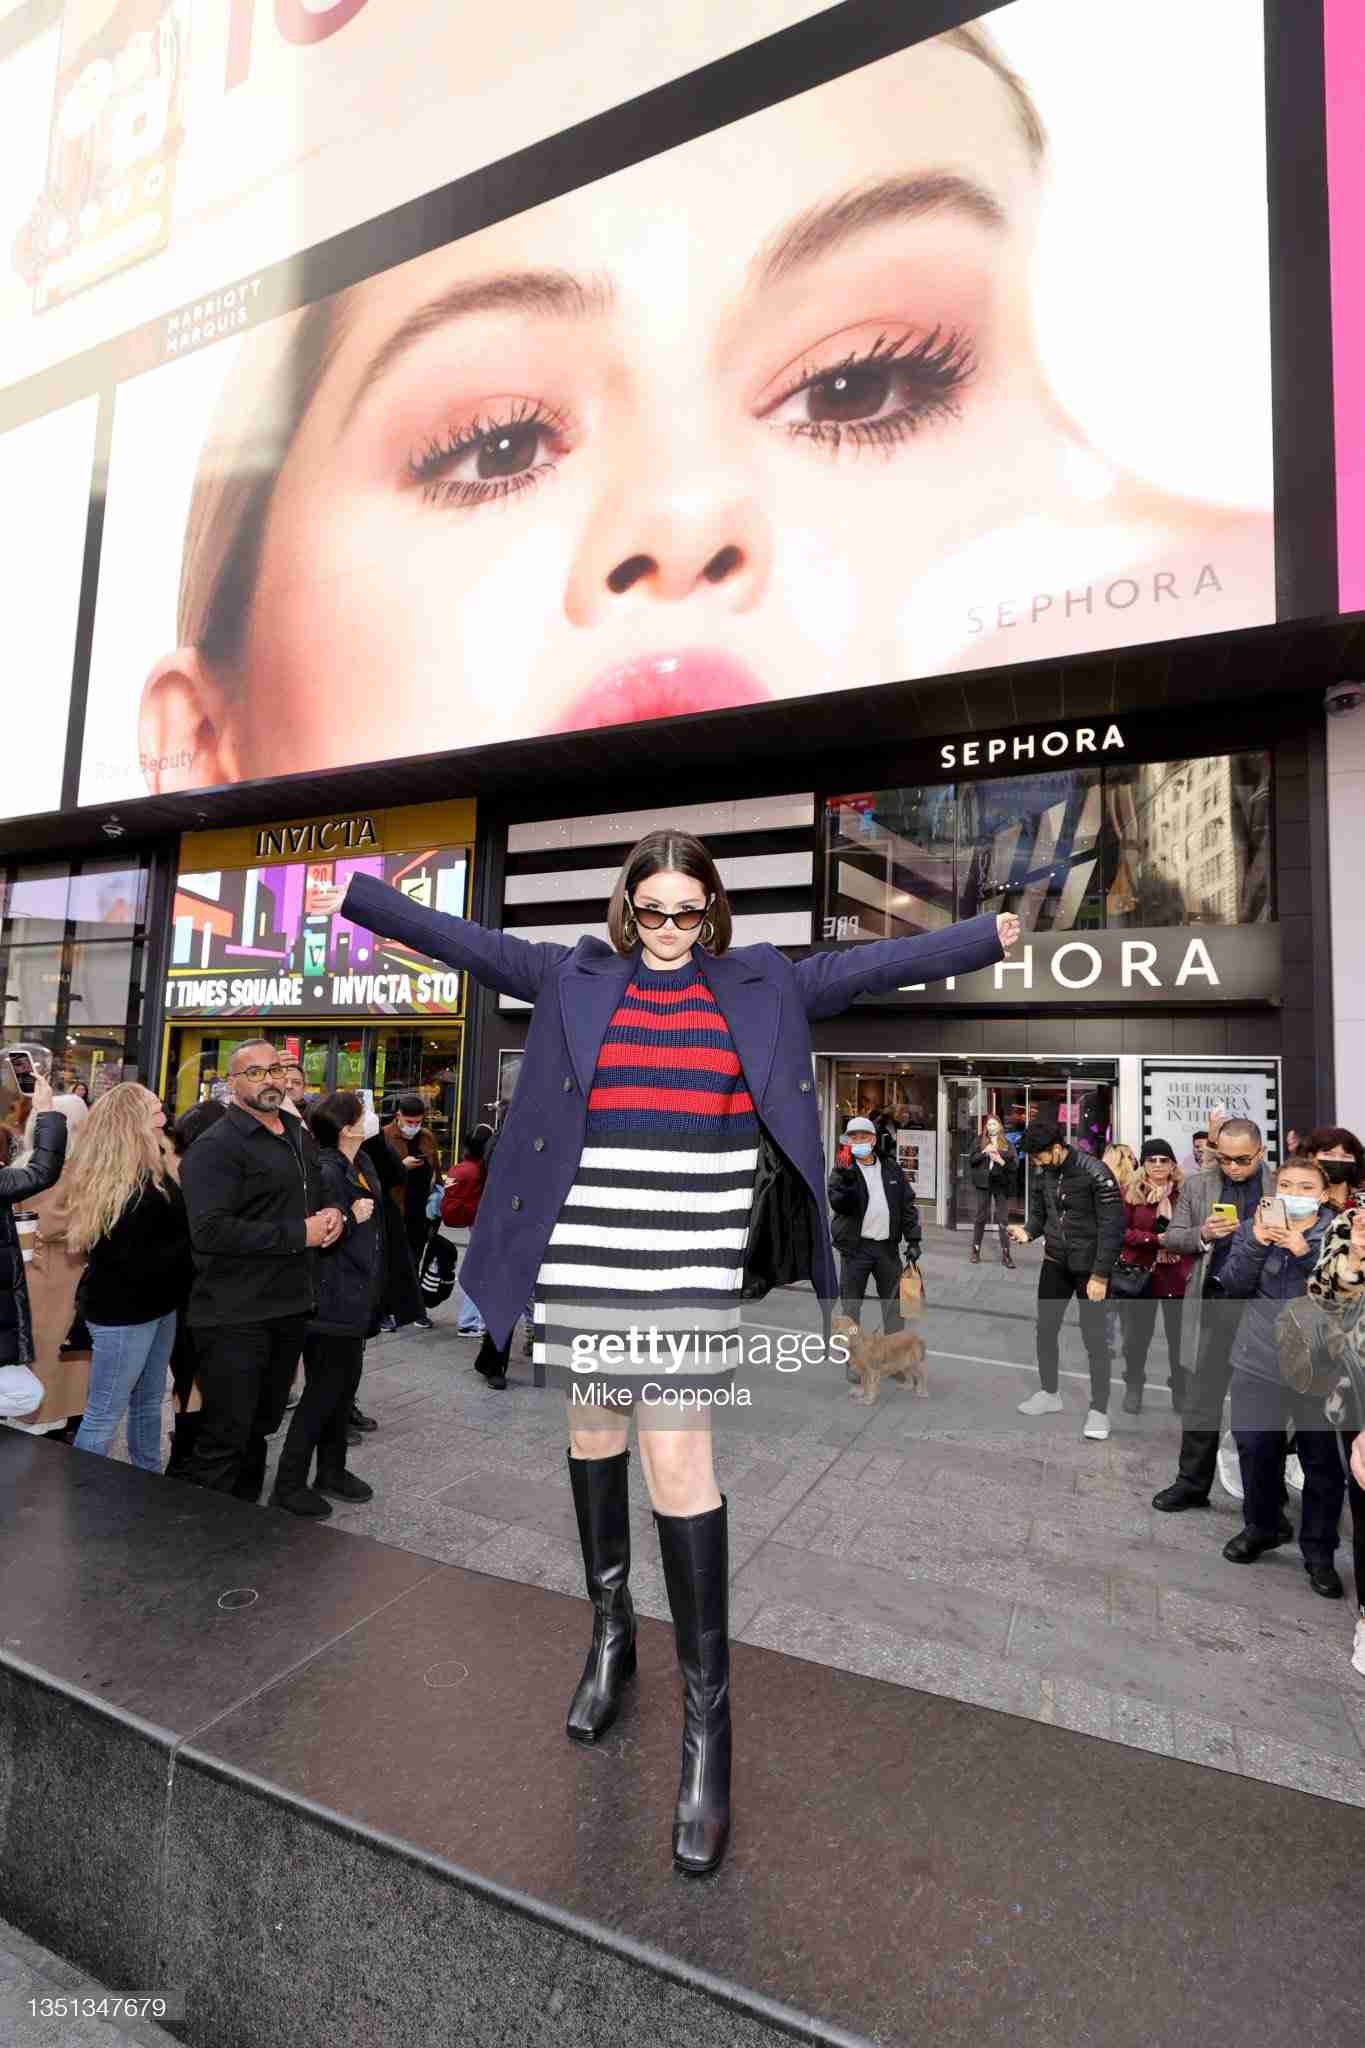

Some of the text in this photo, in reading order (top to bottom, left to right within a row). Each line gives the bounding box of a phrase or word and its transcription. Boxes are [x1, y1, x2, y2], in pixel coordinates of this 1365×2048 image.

[167, 279, 262, 334] MARRIOTT
[166, 305, 248, 353] MARQUIS
[967, 562, 1224, 635] SEPHORA
[940, 724, 1126, 769] SEPHORA
[256, 816, 379, 858] INVICTA
[896, 937, 1222, 991] HORA
[176, 979, 228, 1008] TIMES
[230, 977, 304, 1007] SQUARE
[332, 974, 412, 1005] INVICTA
[416, 972, 459, 1003] STO
[1166, 1095, 1251, 1109] SEPHORA
[1168, 1081, 1250, 1095] THE BIGGEST
[1167, 1110, 1182, 1121] IN
